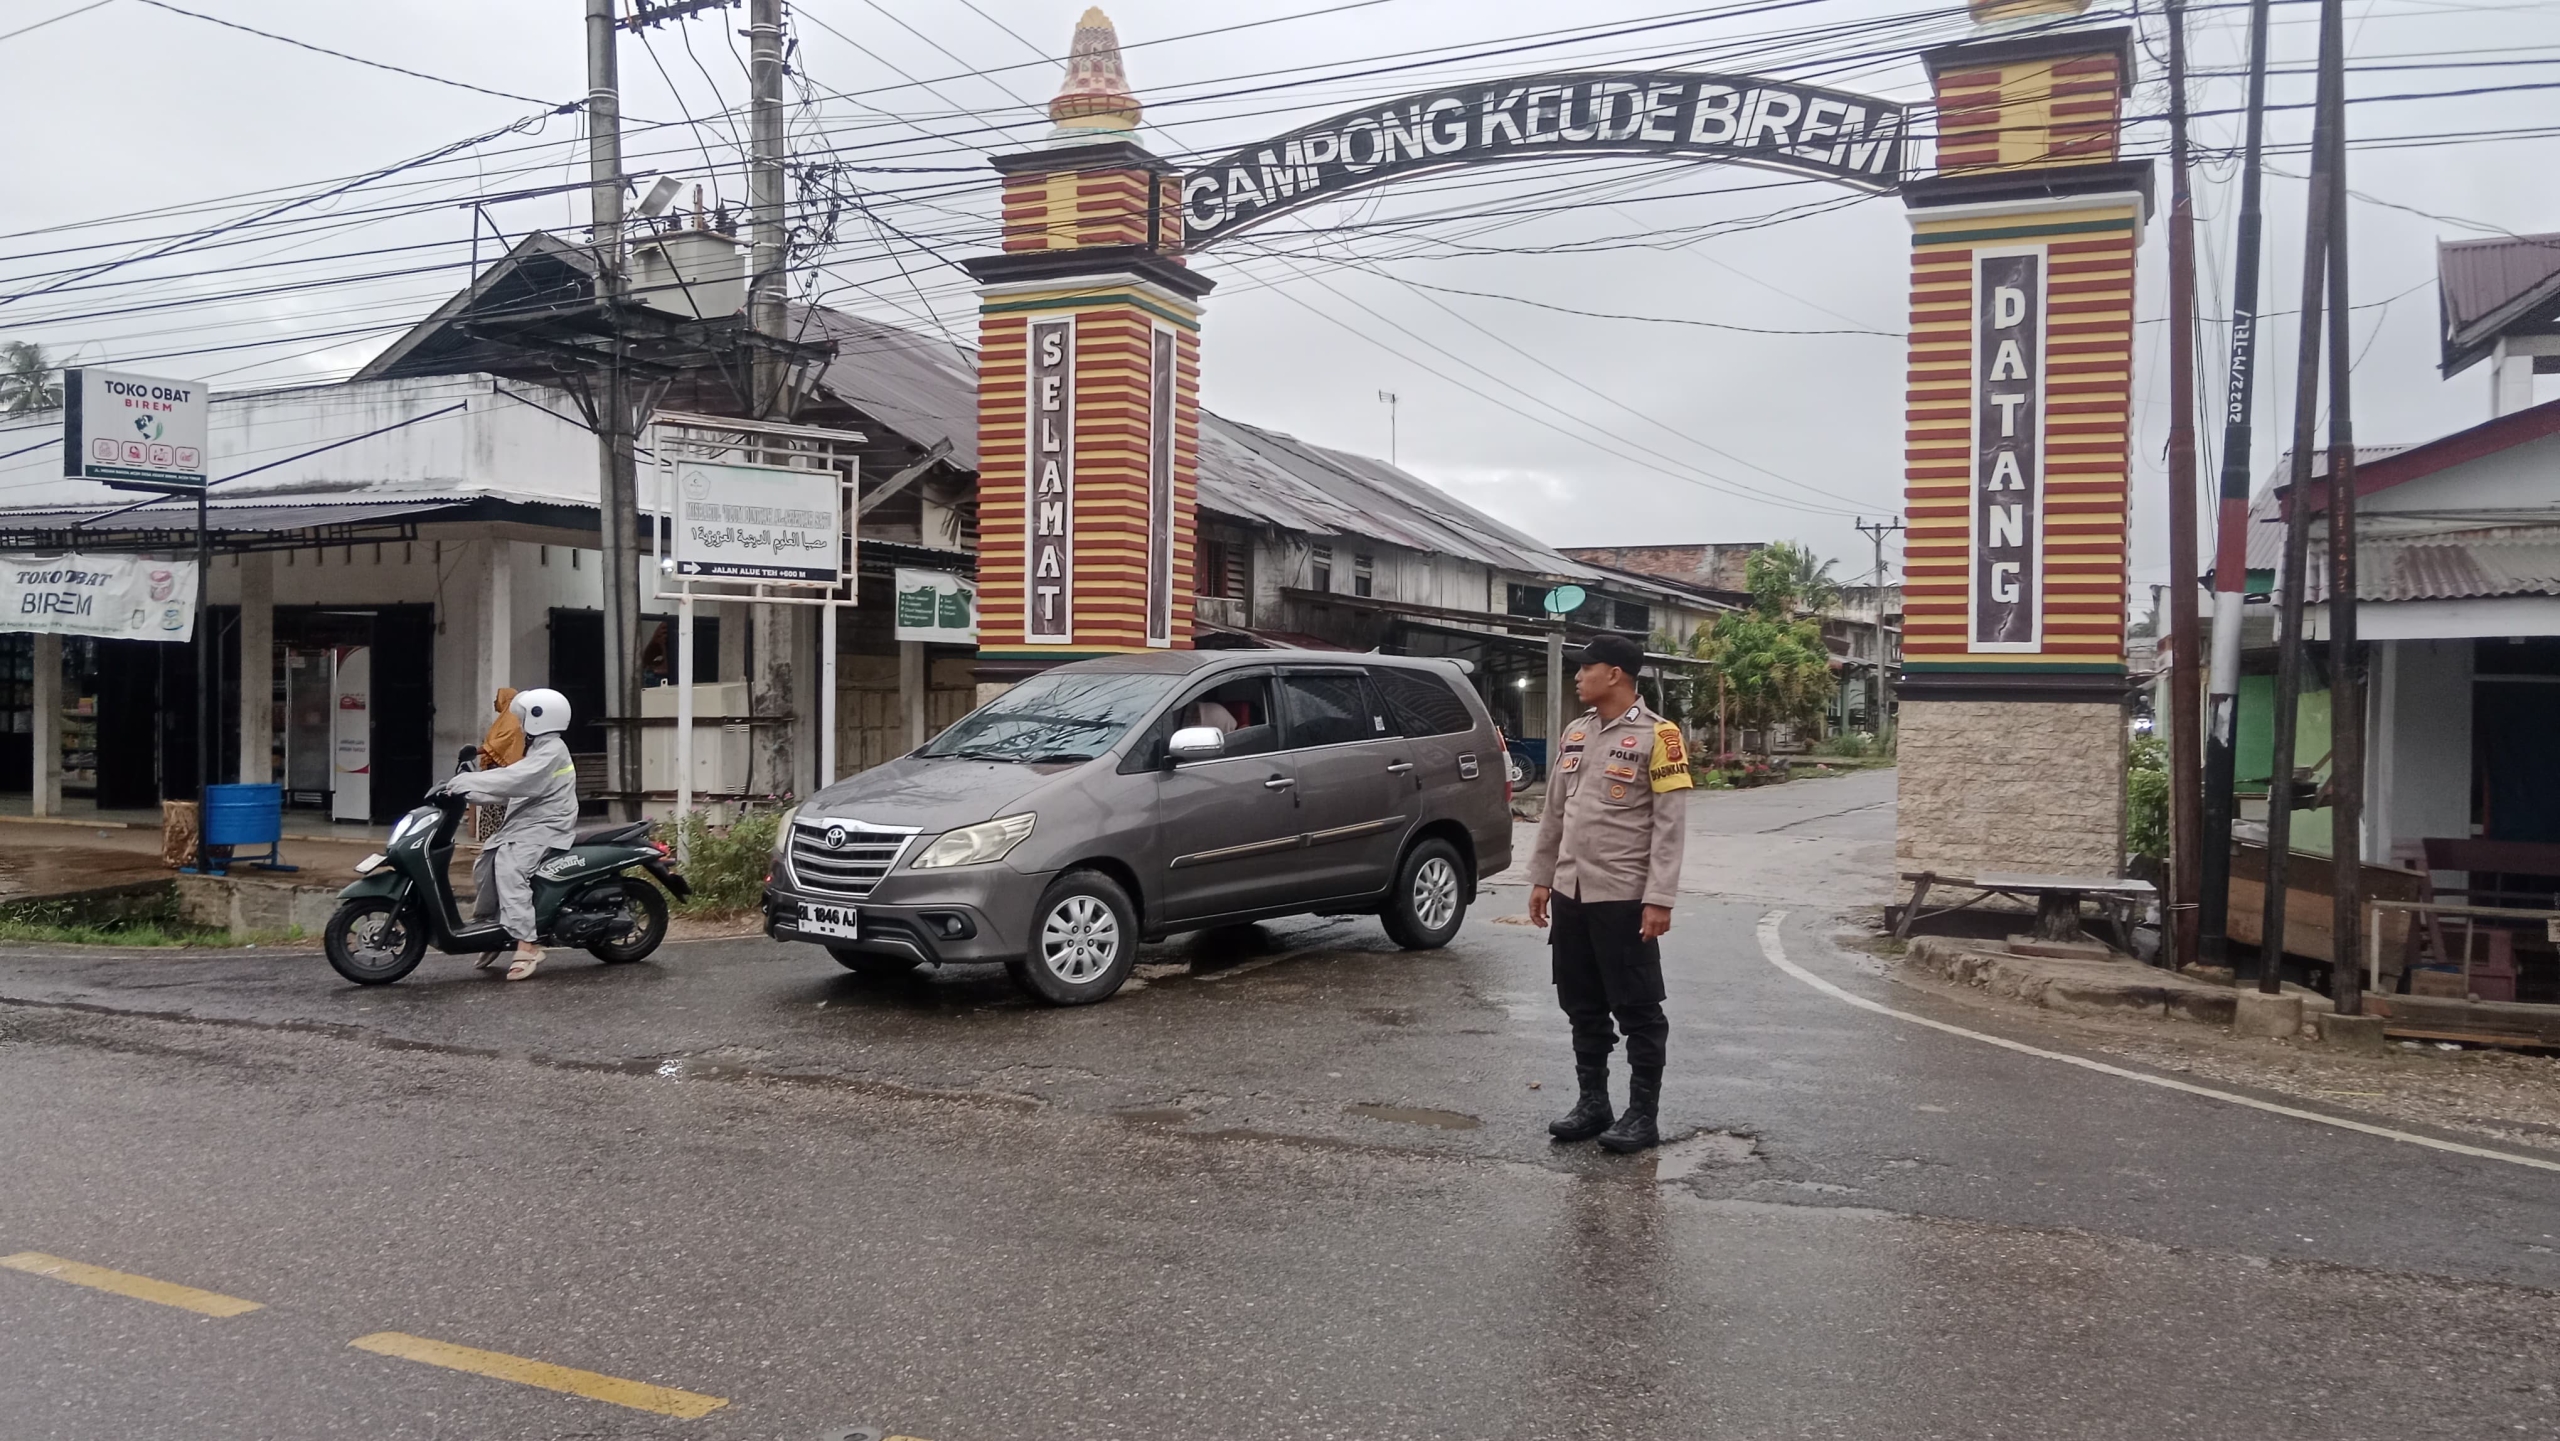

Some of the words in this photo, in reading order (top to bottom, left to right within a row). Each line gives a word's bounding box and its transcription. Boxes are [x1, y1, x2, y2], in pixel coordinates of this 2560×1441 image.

[1183, 97, 1468, 231] GAMPONG
[1481, 81, 1684, 148] KEUDE
[1689, 83, 1900, 175] BIREM
[105, 380, 147, 397] TOKO
[151, 386, 191, 403] OBAT
[125, 398, 172, 412] BIREM
[1987, 286, 2029, 605] DATANG
[1036, 331, 1064, 621] SELAMAT
[773, 530, 800, 555] العلوم
[16, 570, 63, 585] TOKO
[711, 566, 738, 574] JALAN
[739, 568, 760, 576] ALUE
[762, 569, 778, 577] TEH
[21, 592, 93, 616] BIREM
[1609, 749, 1639, 763] POLRI
[843, 910, 856, 927] AJ
